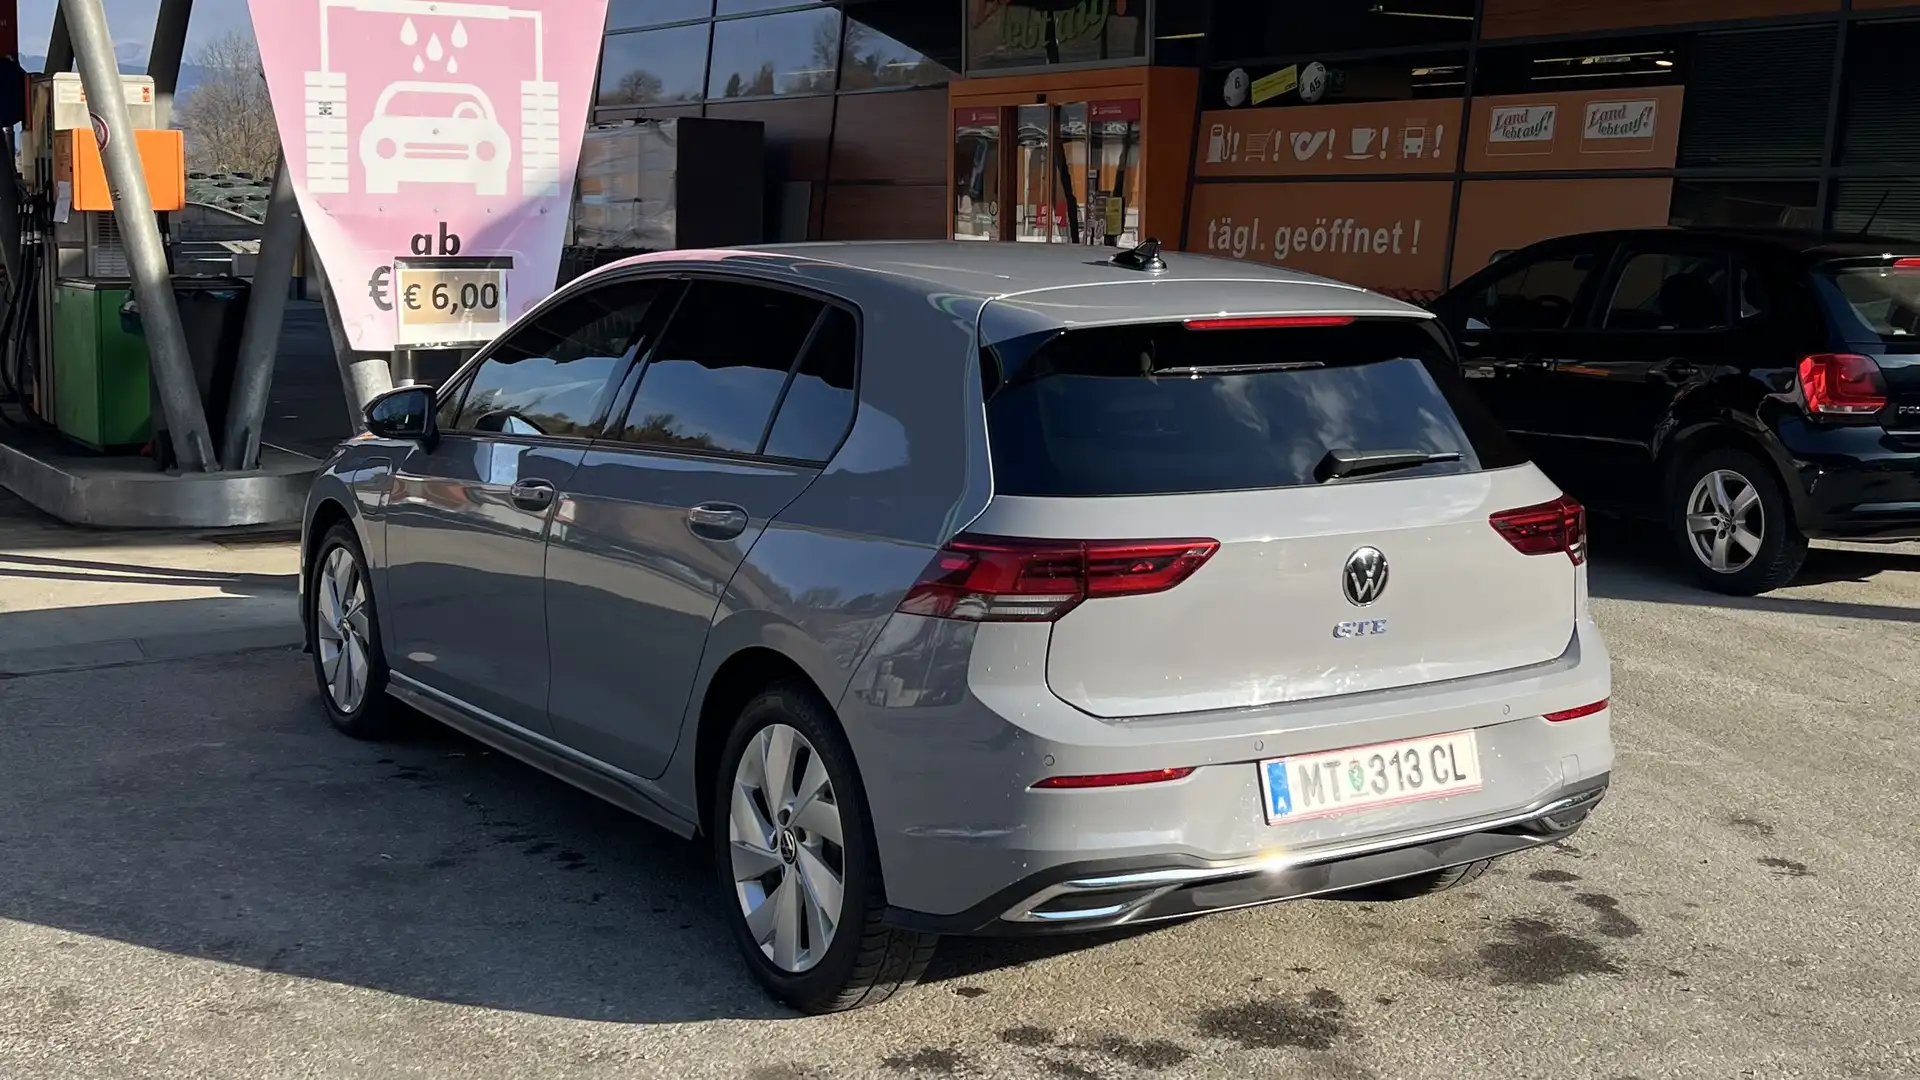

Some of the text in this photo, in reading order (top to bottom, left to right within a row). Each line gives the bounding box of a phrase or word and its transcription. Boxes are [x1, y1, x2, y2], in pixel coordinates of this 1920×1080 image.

[1492, 109, 1530, 133] Land
[1522, 110, 1553, 137] auf!
[1587, 104, 1627, 130] Land
[1620, 106, 1653, 135] auf!
[410, 221, 461, 256] ab
[1207, 217, 1266, 259] tägl.
[1273, 218, 1403, 260] geöffnet
[368, 265, 393, 312] €
[403, 282, 499, 316] € 6,00
[1332, 618, 1388, 639] GTE
[1298, 742, 1467, 807] MT 313 CL
